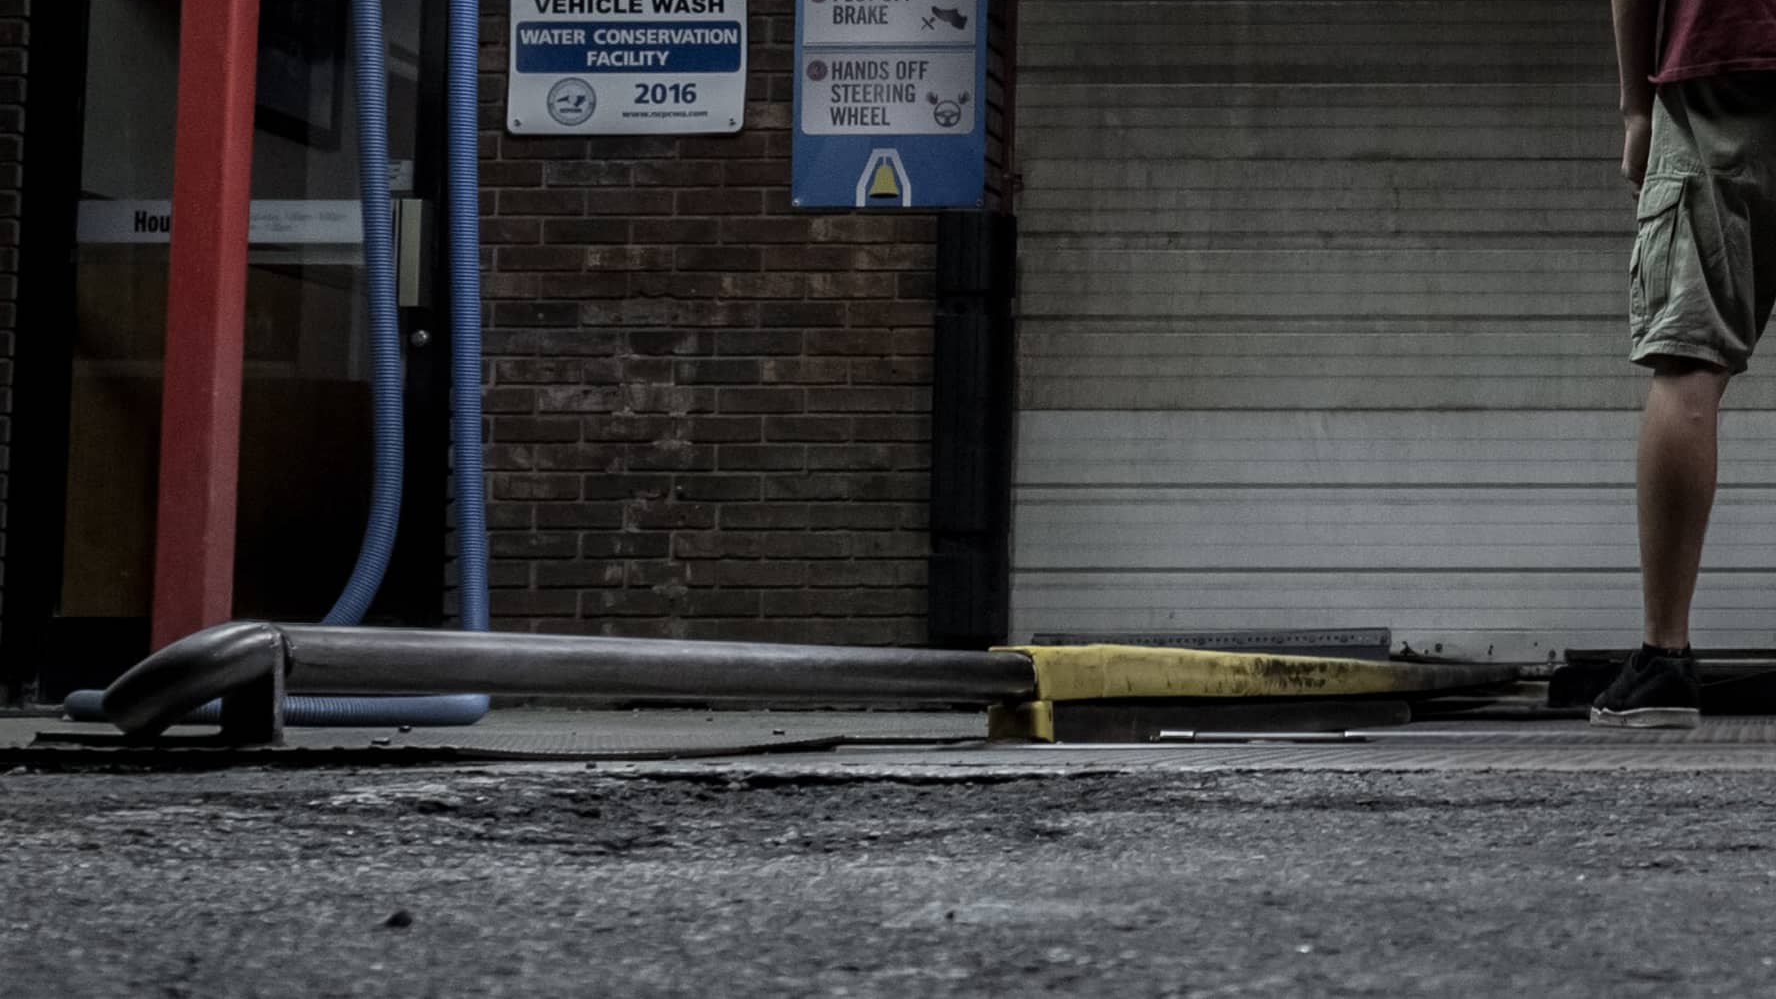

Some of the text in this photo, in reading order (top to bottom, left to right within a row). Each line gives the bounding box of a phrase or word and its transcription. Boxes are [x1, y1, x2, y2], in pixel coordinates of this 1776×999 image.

[832, 5, 888, 25] BRAKE
[520, 28, 738, 45] WATER CONSERVATION
[586, 50, 670, 67] FACILITY
[831, 61, 889, 80] HANDS
[895, 61, 929, 80] OFF
[634, 83, 697, 105] 2016
[830, 84, 916, 104] STEERING
[830, 107, 891, 126] WHEEL
[134, 211, 171, 233] Hou
